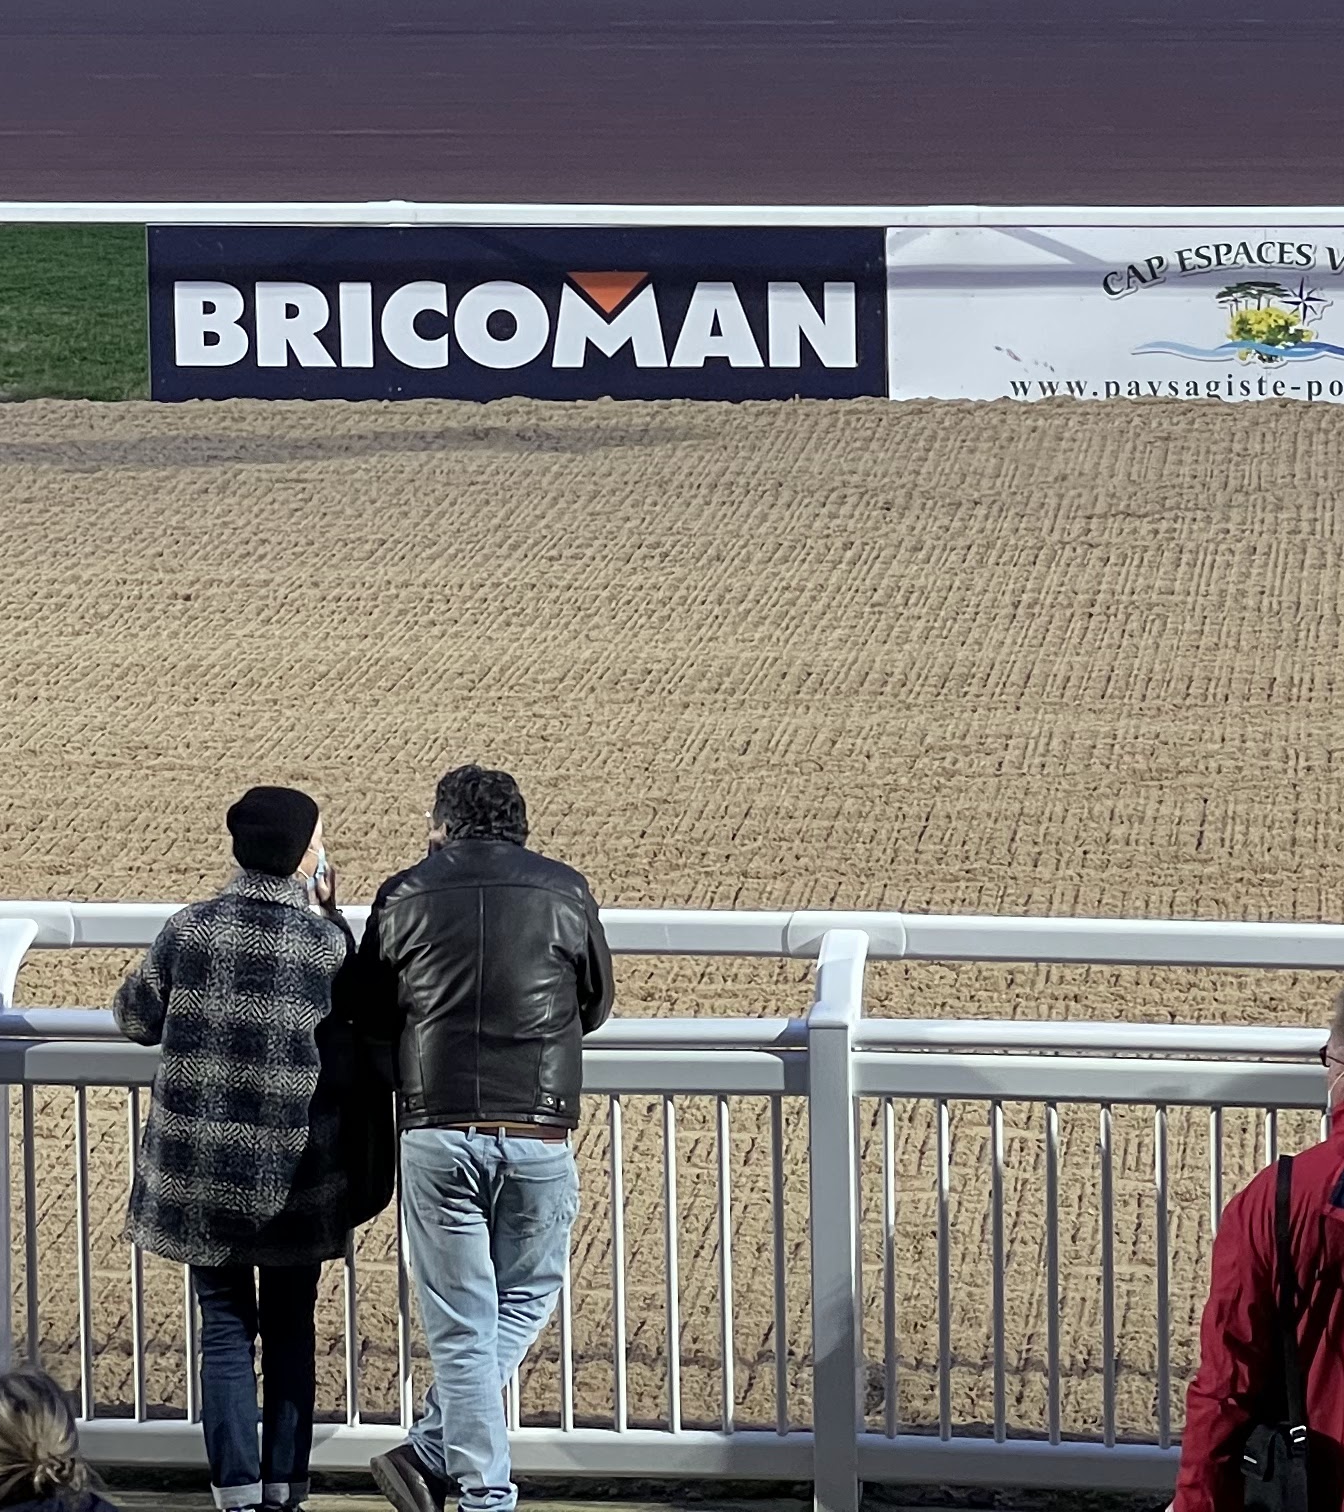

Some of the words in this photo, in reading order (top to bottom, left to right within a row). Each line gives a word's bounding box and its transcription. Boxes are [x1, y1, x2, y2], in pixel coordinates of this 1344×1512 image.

[1103, 255, 1164, 295] CAP
[1175, 241, 1313, 273] ESPACES
[174, 281, 857, 369] BRICOMAN
